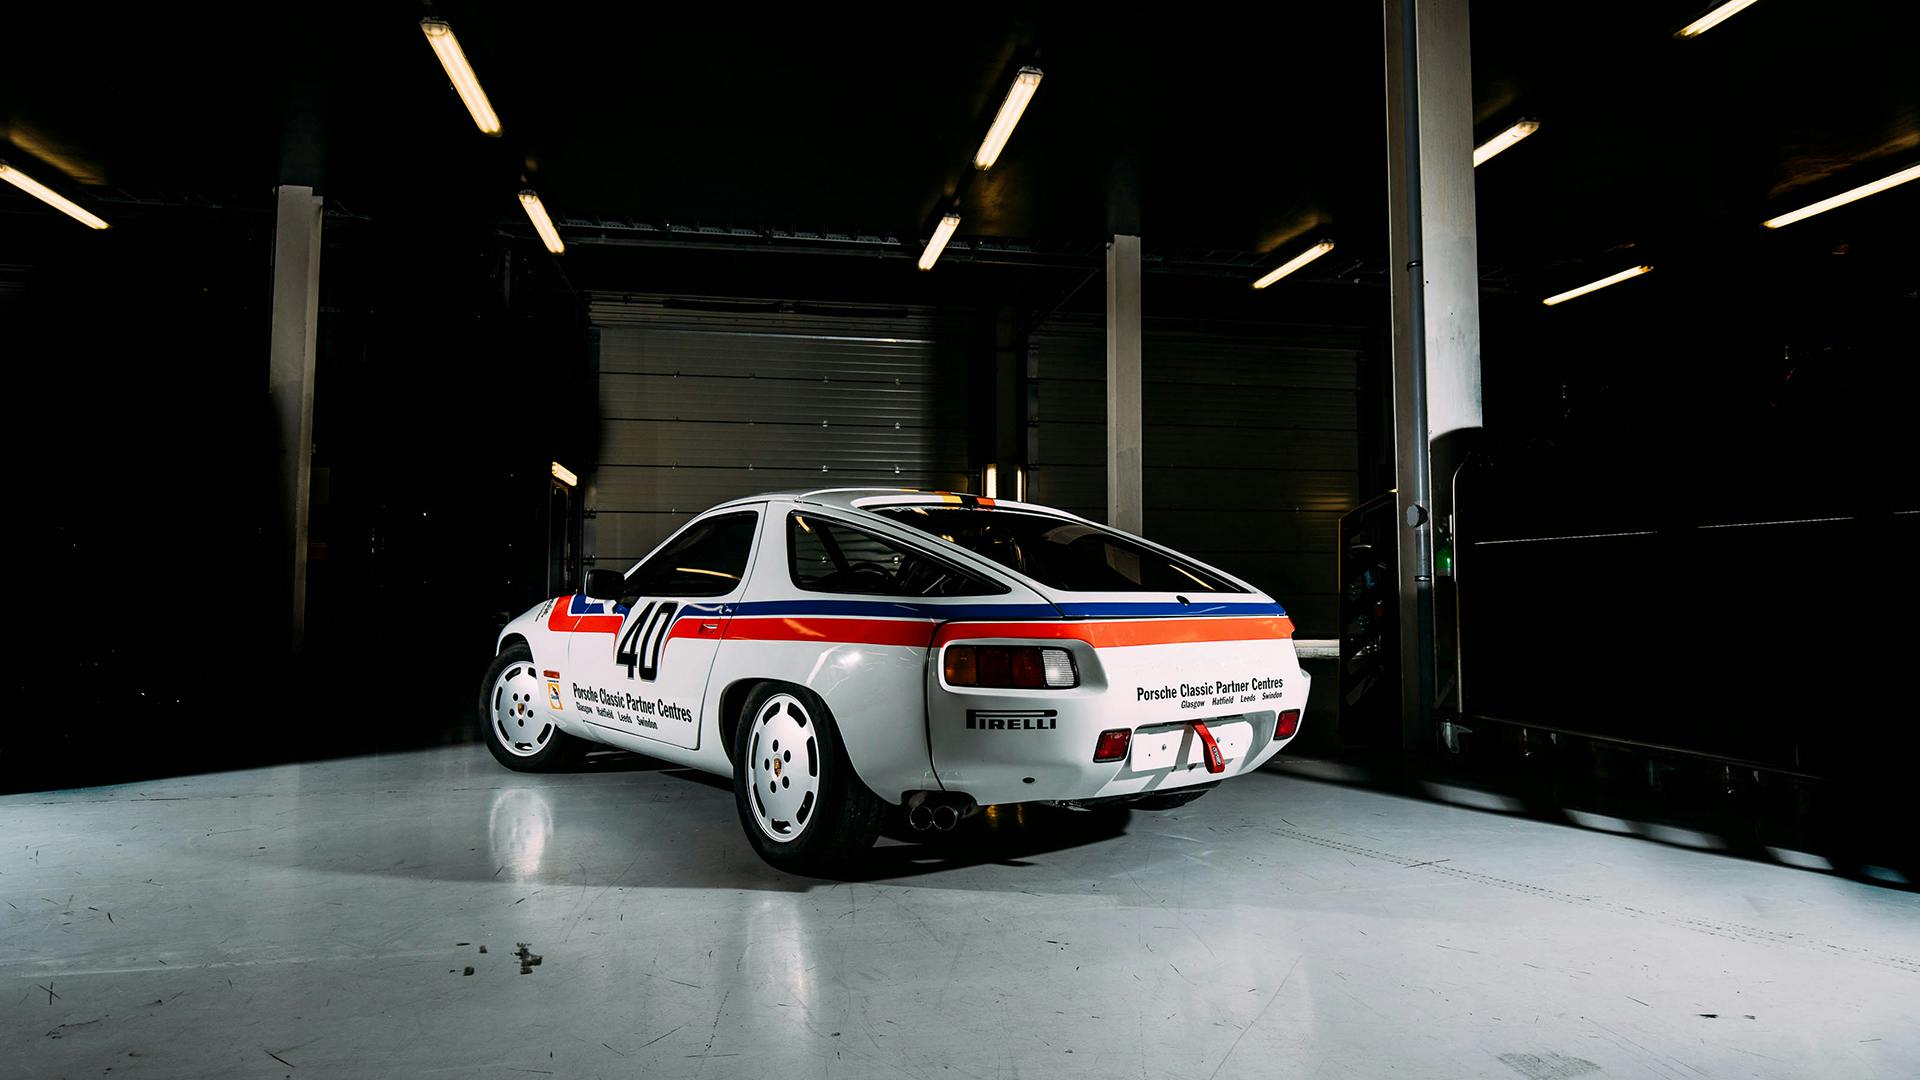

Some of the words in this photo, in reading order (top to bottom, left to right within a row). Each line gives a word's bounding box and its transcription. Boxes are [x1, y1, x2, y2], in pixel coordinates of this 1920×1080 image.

[616, 600, 679, 682] 40
[1136, 686, 1177, 701] Porsche
[1180, 682, 1214, 698] Classic
[1216, 679, 1249, 694] Partner
[1251, 677, 1283, 691] Centres
[1181, 699, 1205, 709] Glasgow
[1211, 695, 1234, 706] Hatfield
[1240, 693, 1256, 703] Leeds
[1262, 692, 1282, 700] Swindon
[573, 683, 599, 702] Porsche
[600, 688, 625, 708] Classic
[626, 693, 655, 715] Partner
[658, 699, 692, 722] Centres
[617, 711, 633, 724] Leeds
[636, 716, 658, 729] Swindon
[965, 708, 1058, 730] PIRELLI
